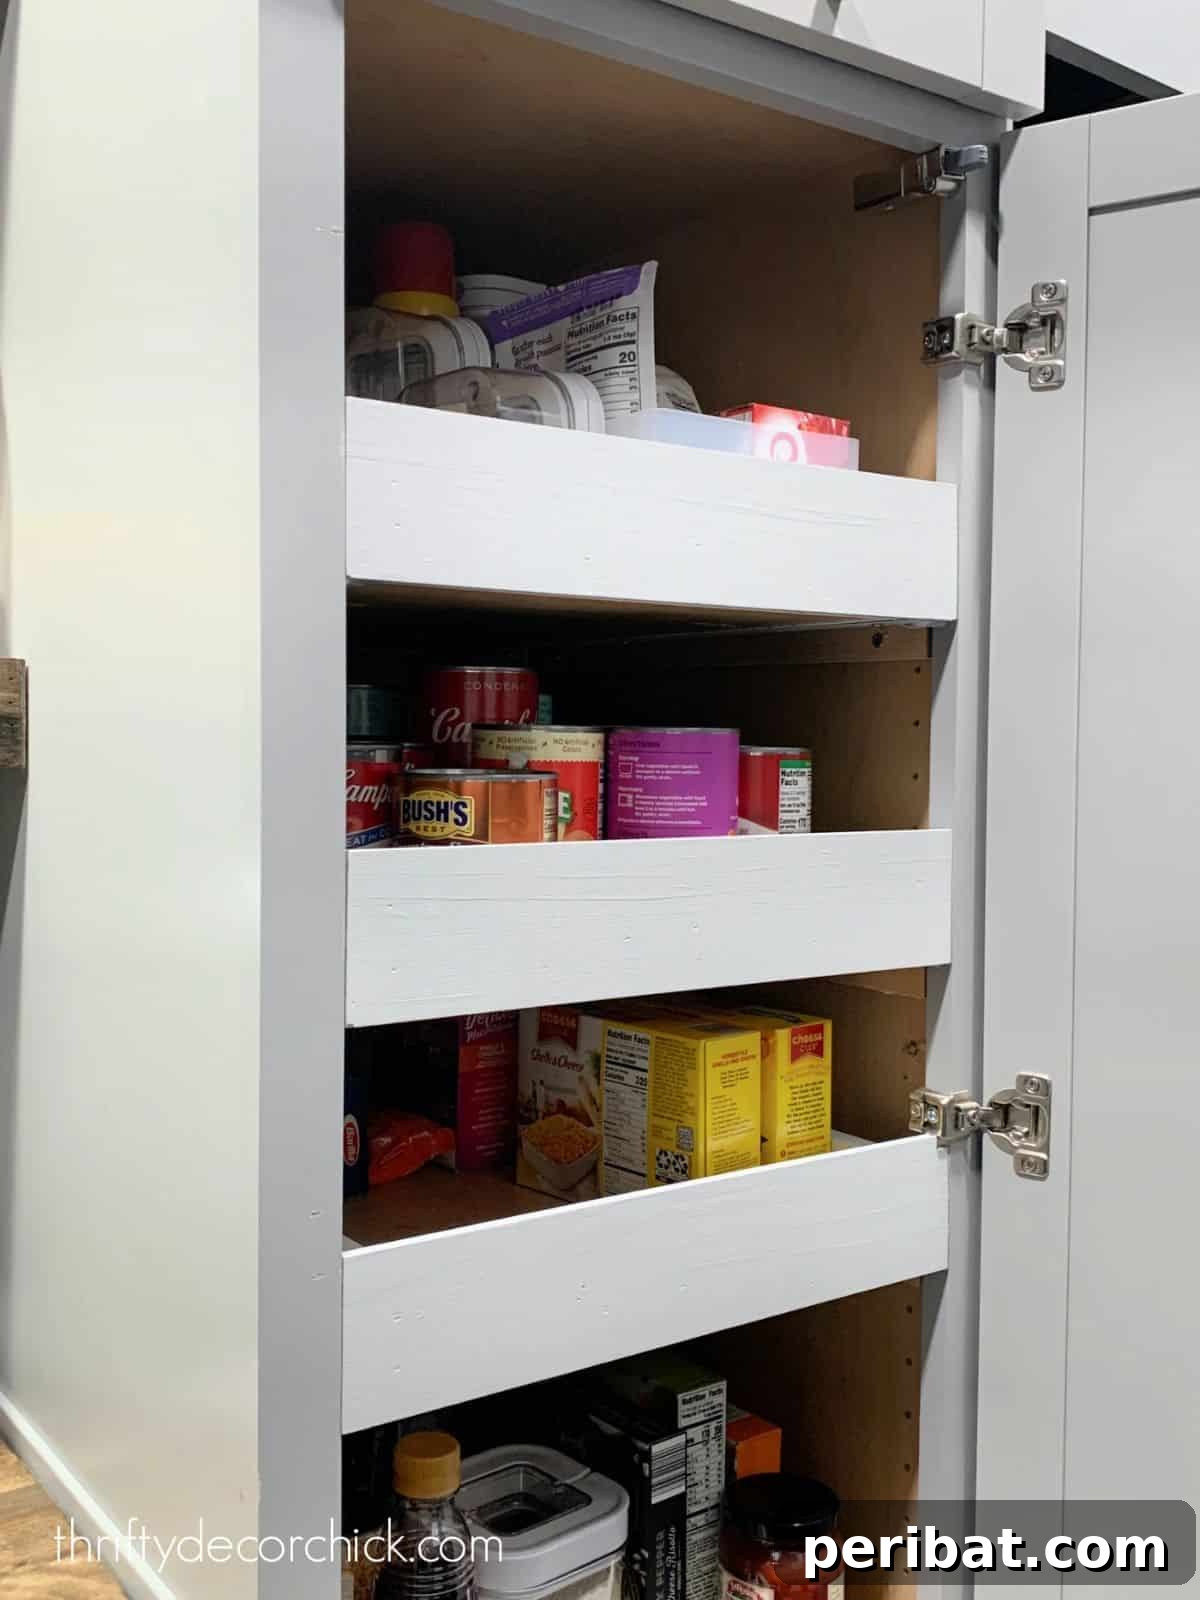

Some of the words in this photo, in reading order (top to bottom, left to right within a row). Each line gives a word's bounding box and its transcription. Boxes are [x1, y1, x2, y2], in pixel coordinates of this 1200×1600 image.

[606, 310, 637, 326] Facts
[618, 351, 636, 363] 20
[403, 798, 469, 827] BUSH'S
